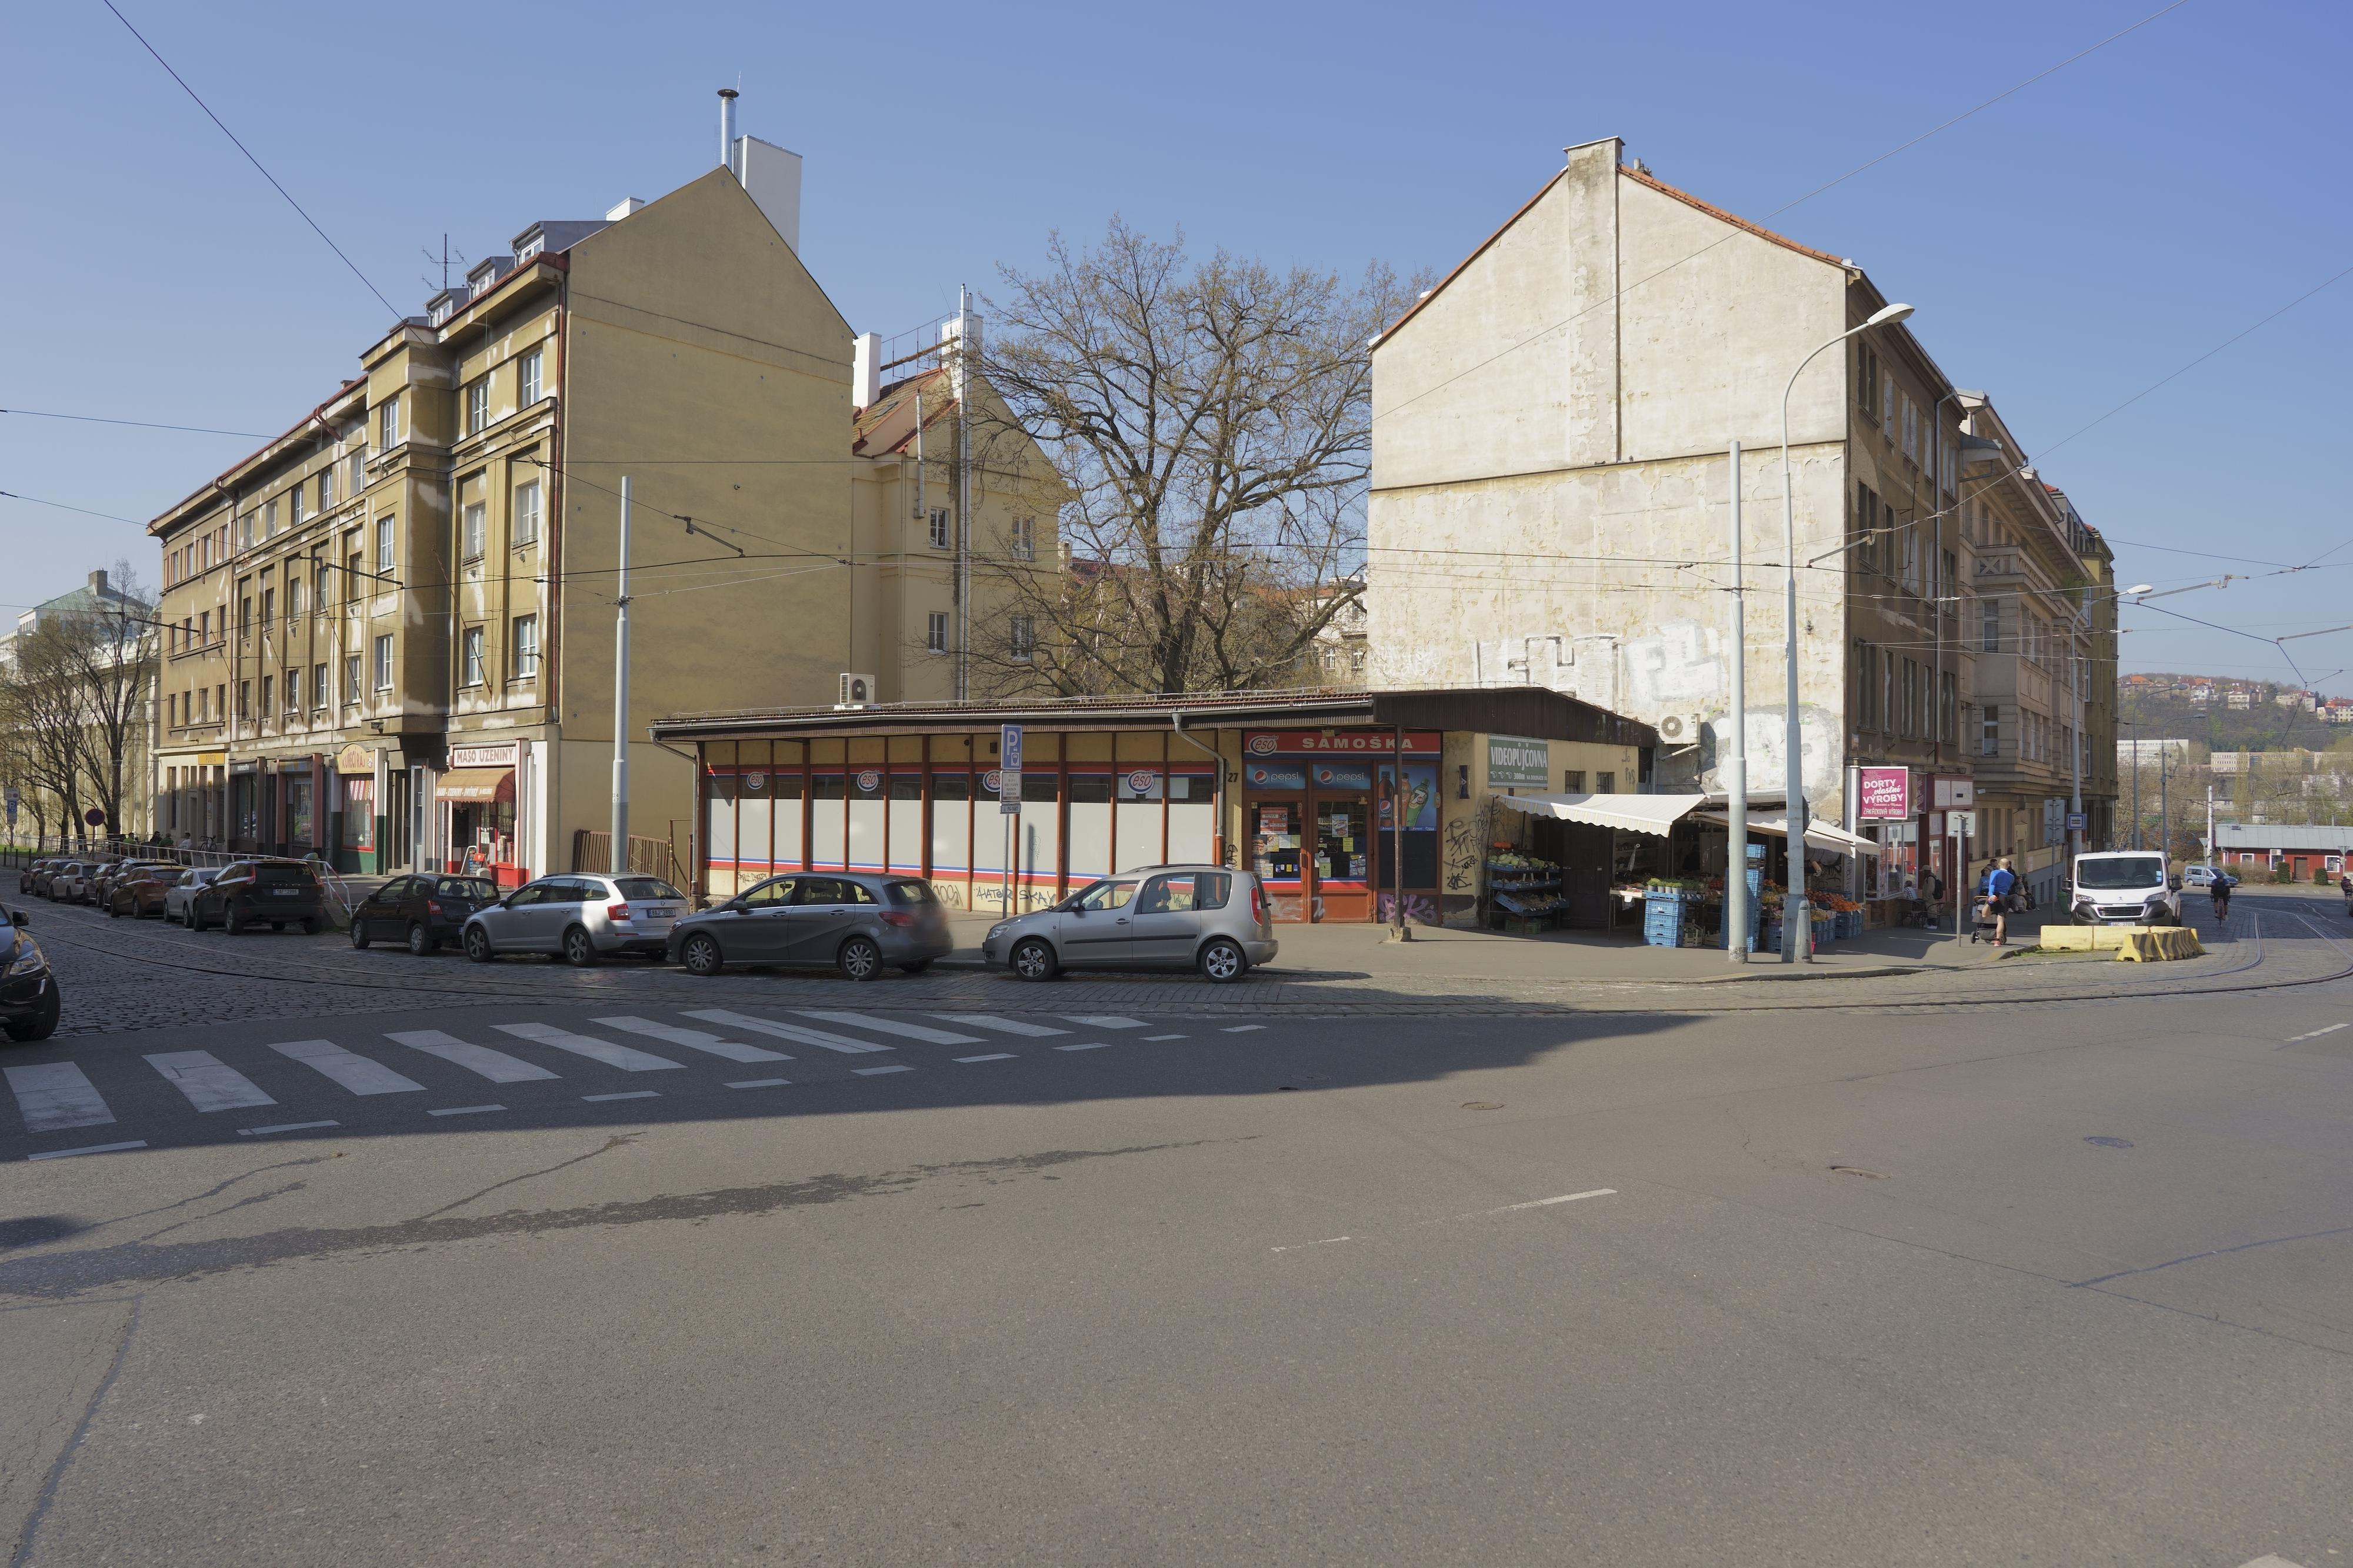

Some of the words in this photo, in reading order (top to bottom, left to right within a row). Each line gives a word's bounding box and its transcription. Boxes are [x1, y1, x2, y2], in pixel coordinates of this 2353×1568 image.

[1007, 730, 1018, 755] P
[1255, 739, 1274, 749] eso
[457, 750, 476, 763] MASO
[479, 748, 514, 762] UZENINY
[1490, 742, 1548, 771] VIDEOPŮJČOVNA
[751, 776, 762, 784] eso
[862, 775, 876, 785] eso
[1132, 775, 1151, 786] eso
[1228, 773, 1238, 782] 27
[1271, 772, 1299, 782] pepsi
[1336, 772, 1365, 782] pepsi
[1864, 779, 1896, 789] DORTY
[1874, 785, 1902, 795] vlastní
[1863, 793, 1904, 804] VÝROBY
